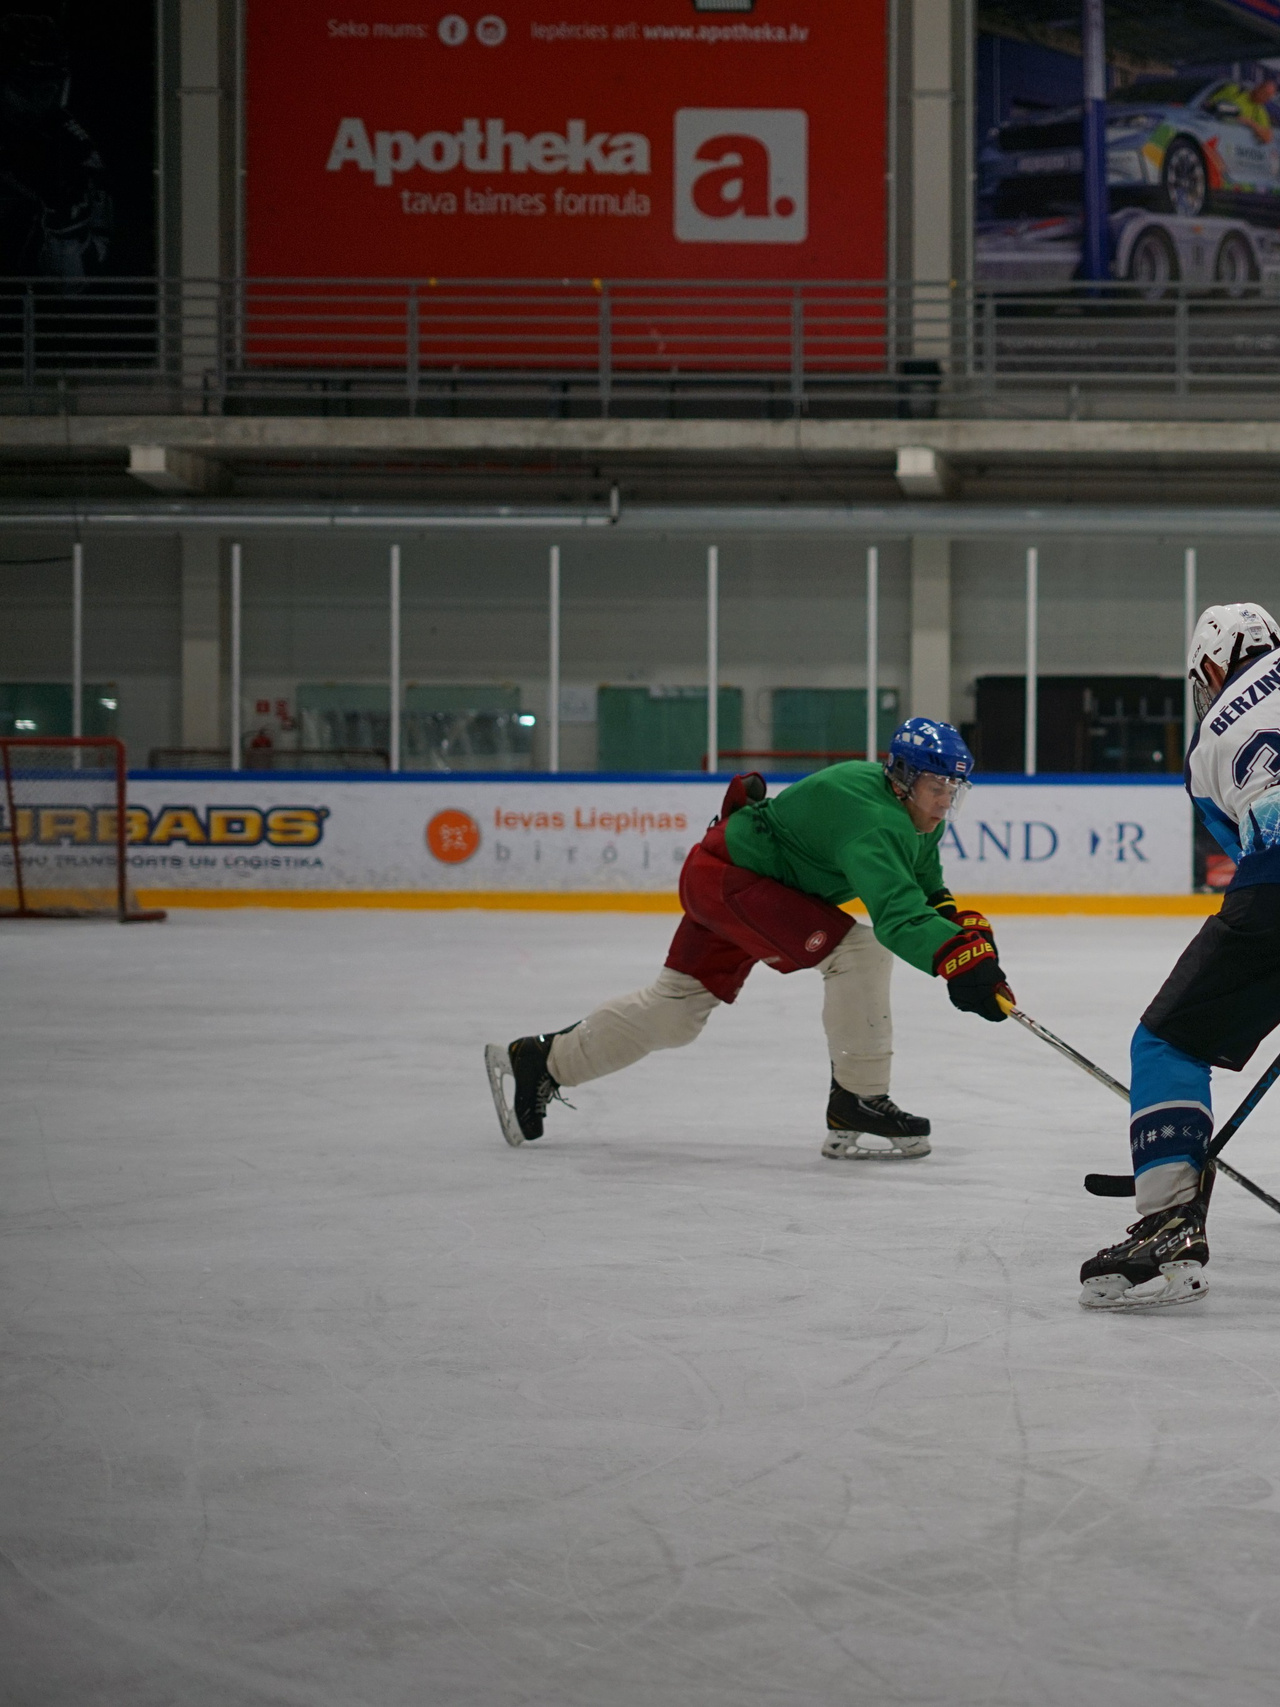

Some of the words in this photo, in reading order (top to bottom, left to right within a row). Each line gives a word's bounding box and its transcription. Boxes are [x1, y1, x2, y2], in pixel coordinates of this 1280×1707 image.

[327, 19, 372, 38] Seko
[643, 23, 809, 43] www.apotheka.lv
[325, 117, 650, 187] Apotheka
[401, 189, 458, 215] tava
[463, 188, 546, 216] laimes
[553, 188, 650, 217] formula
[494, 807, 566, 829] Ievas
[574, 807, 688, 834] Liepiņas
[1155, 1226, 1195, 1257] CCM
